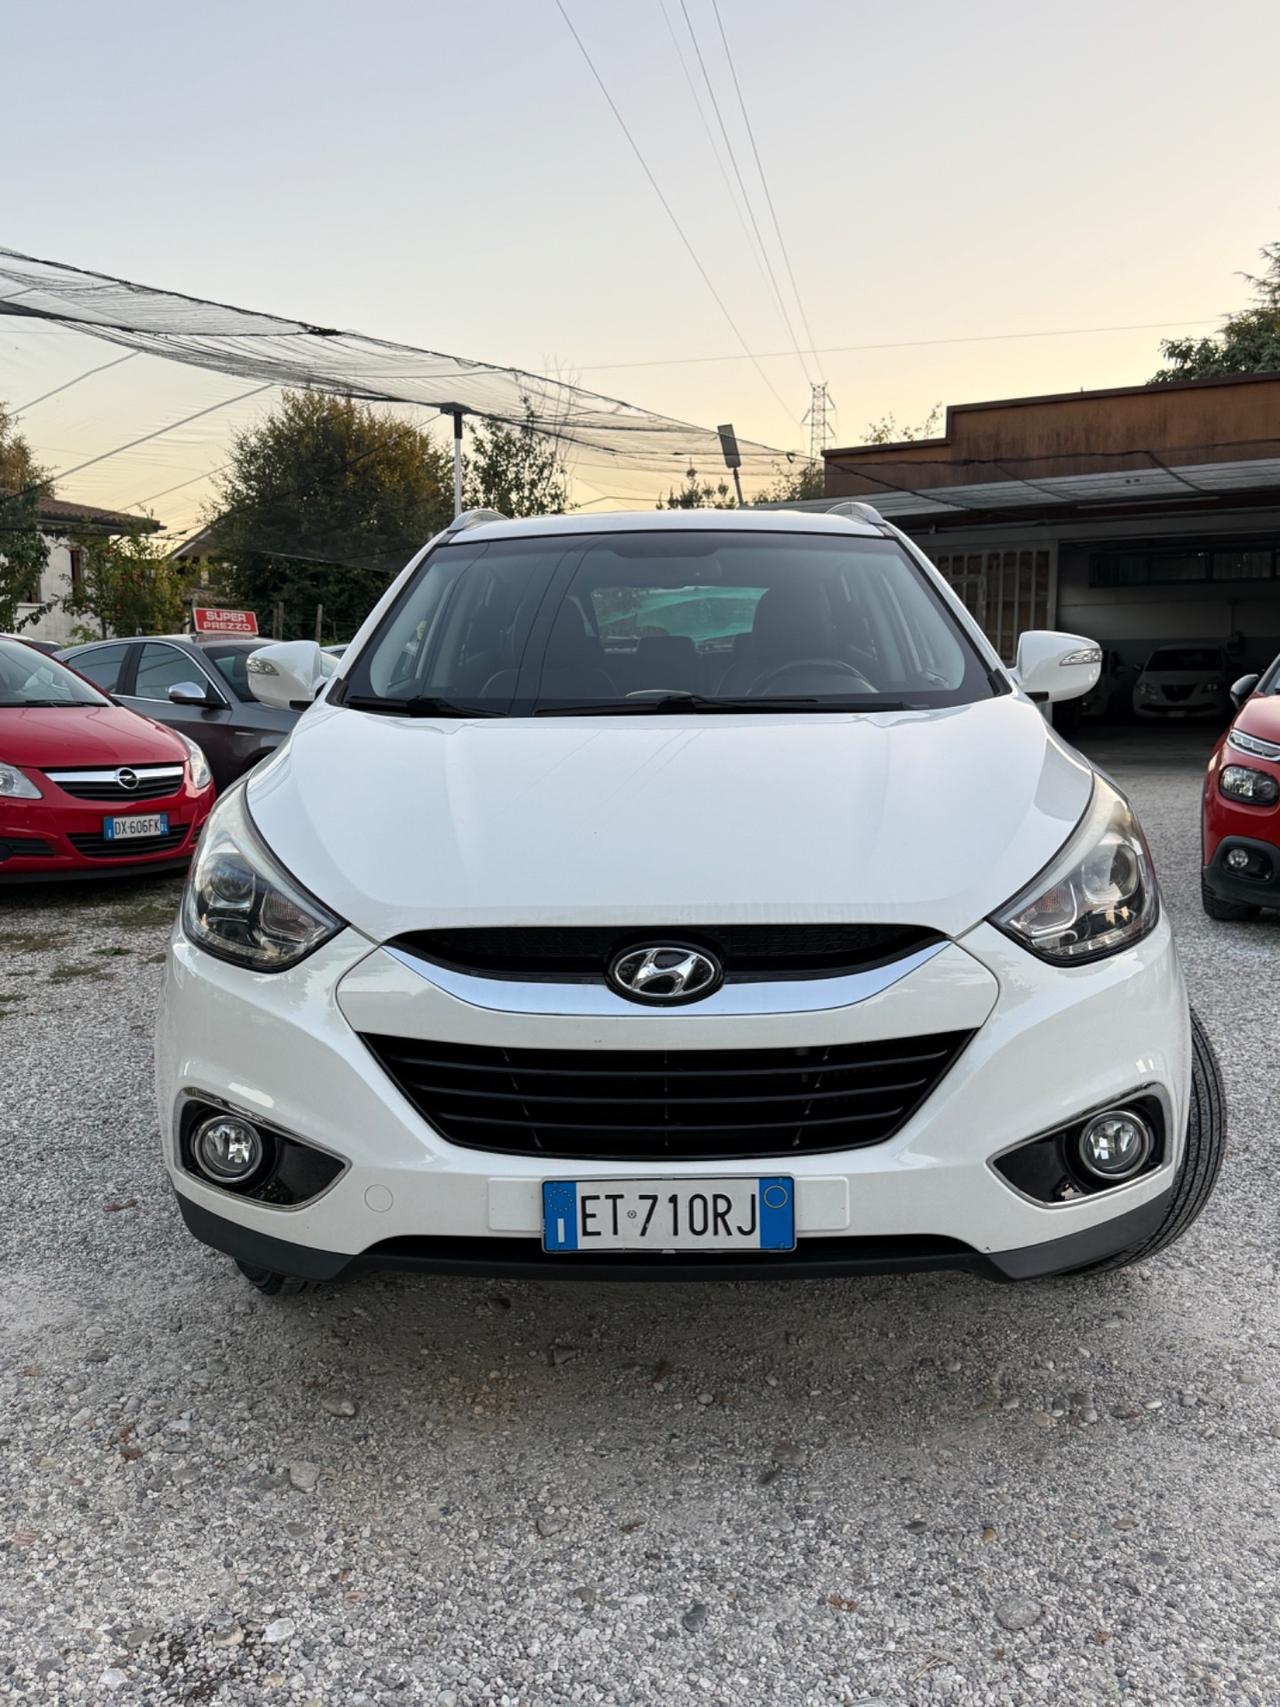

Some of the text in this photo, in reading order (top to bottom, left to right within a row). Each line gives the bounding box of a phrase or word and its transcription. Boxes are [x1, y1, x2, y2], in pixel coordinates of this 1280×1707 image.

[206, 611, 247, 622] SUPER
[203, 621, 252, 631] PREZZO
[580, 1194, 625, 1237] ET
[638, 1193, 757, 1237] 710RJ
